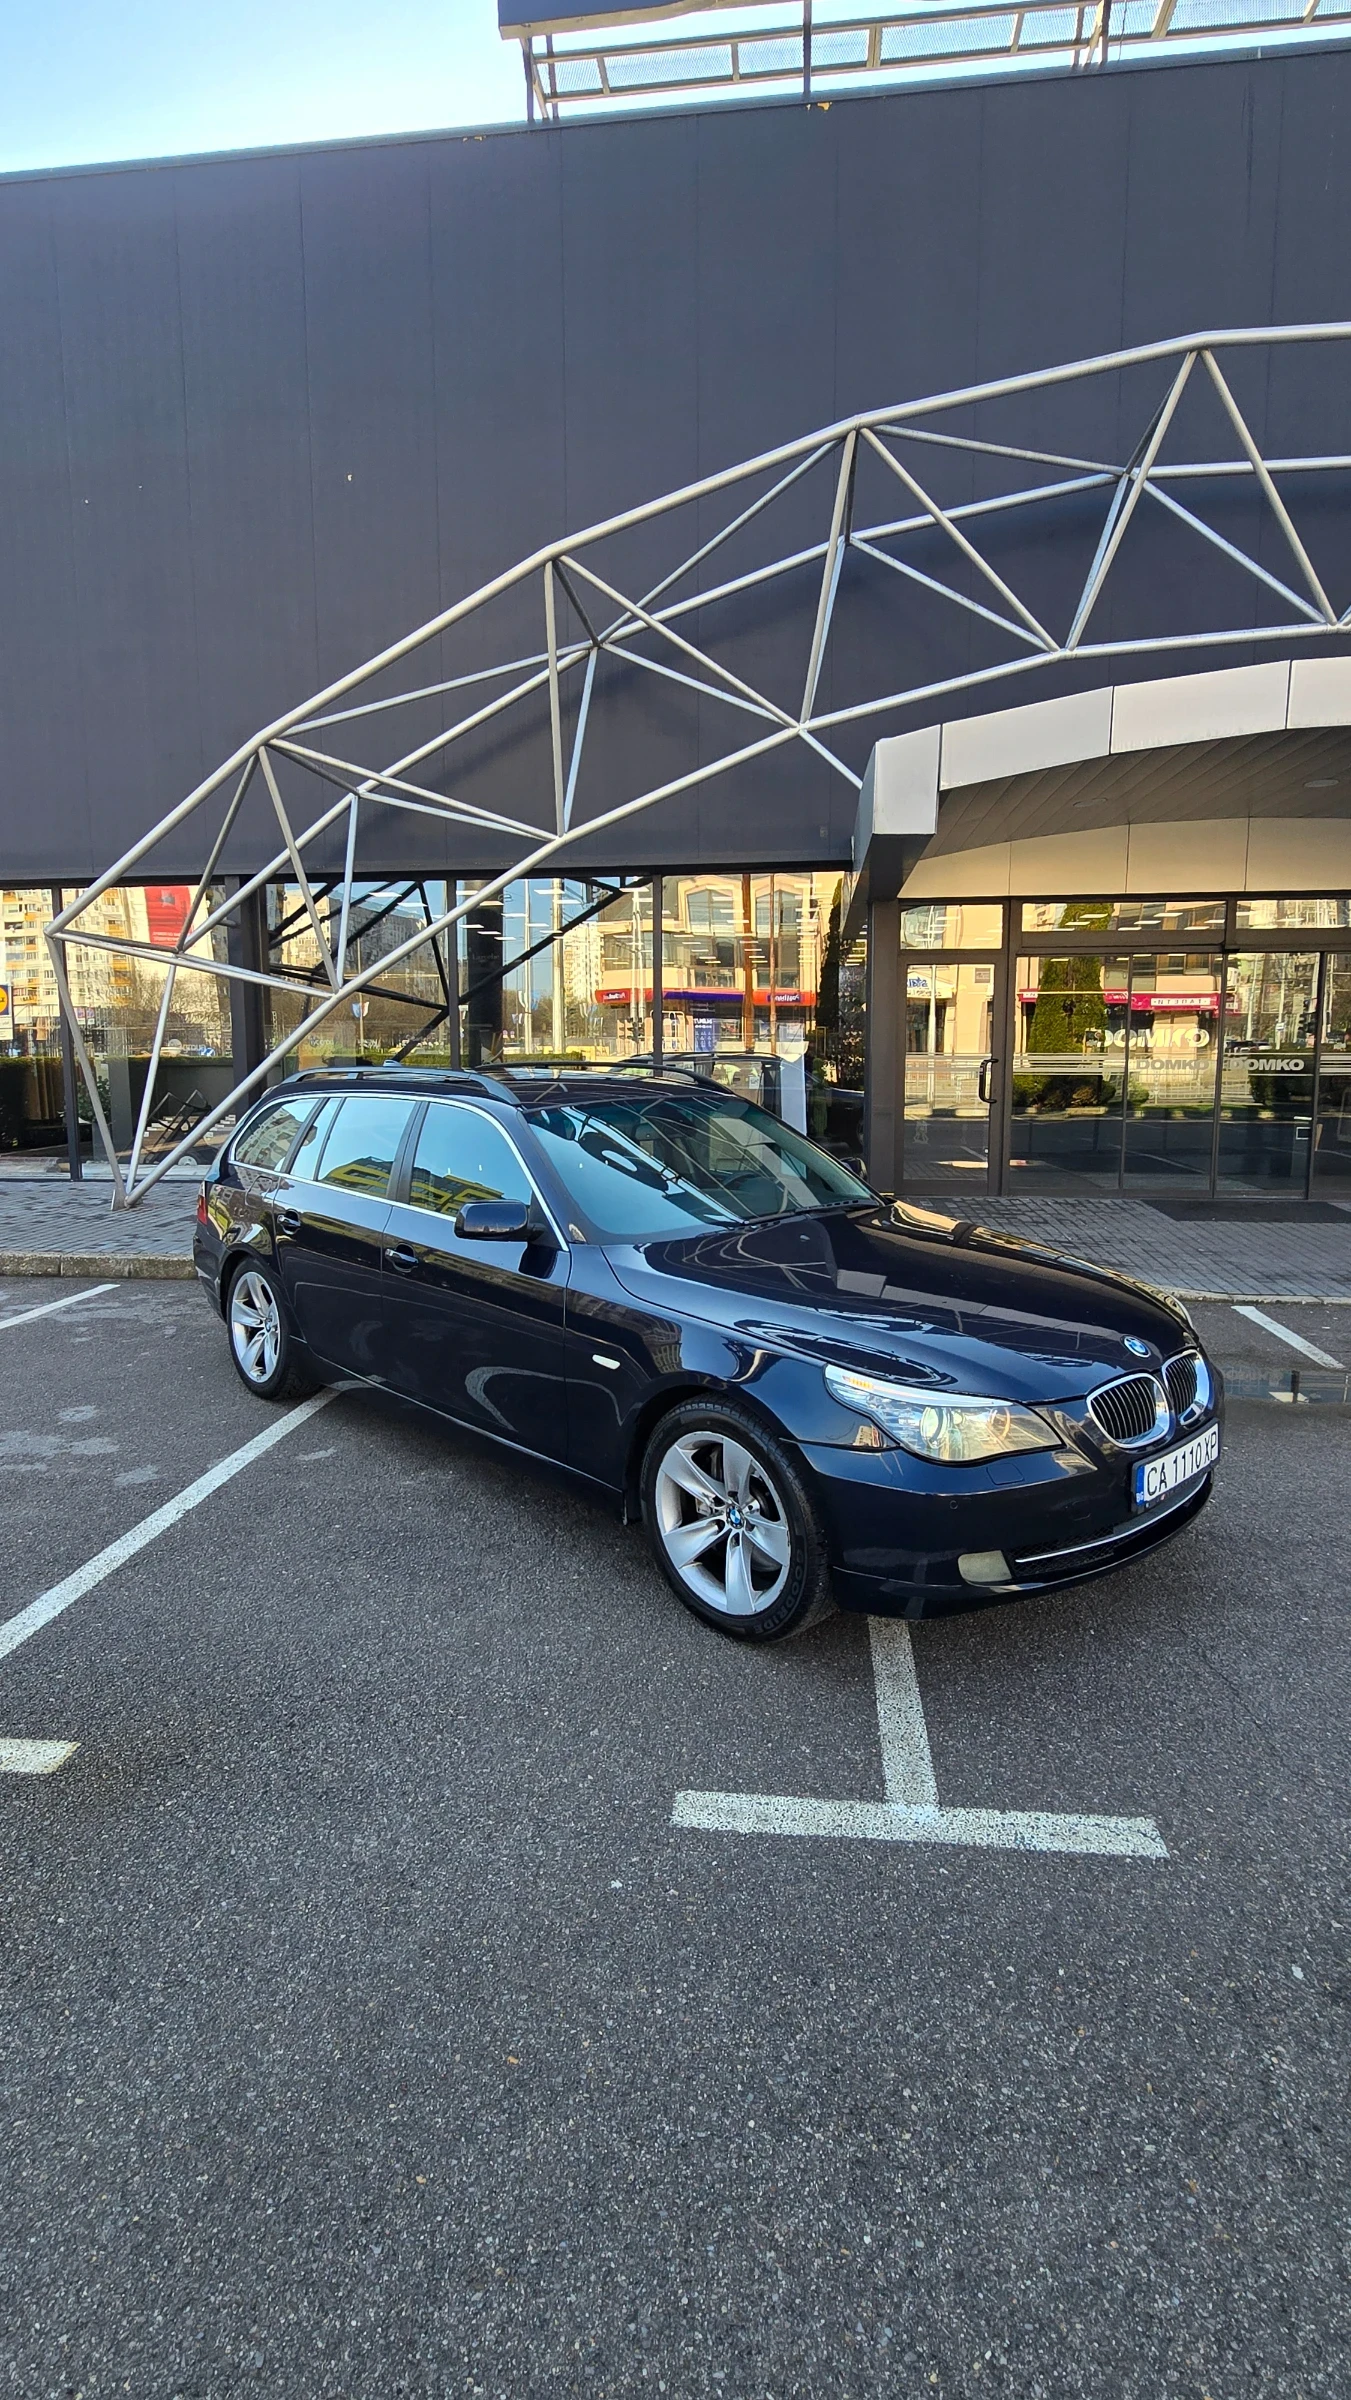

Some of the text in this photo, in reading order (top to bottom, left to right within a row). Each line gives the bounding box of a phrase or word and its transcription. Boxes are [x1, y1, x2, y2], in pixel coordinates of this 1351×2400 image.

[1136, 1058, 1209, 1071] DOMKO
[1229, 1058, 1305, 1072] DOMKO
[1147, 1461, 1168, 1497] CA
[1172, 1441, 1202, 1484] 1110
[1203, 1430, 1217, 1465] XP
